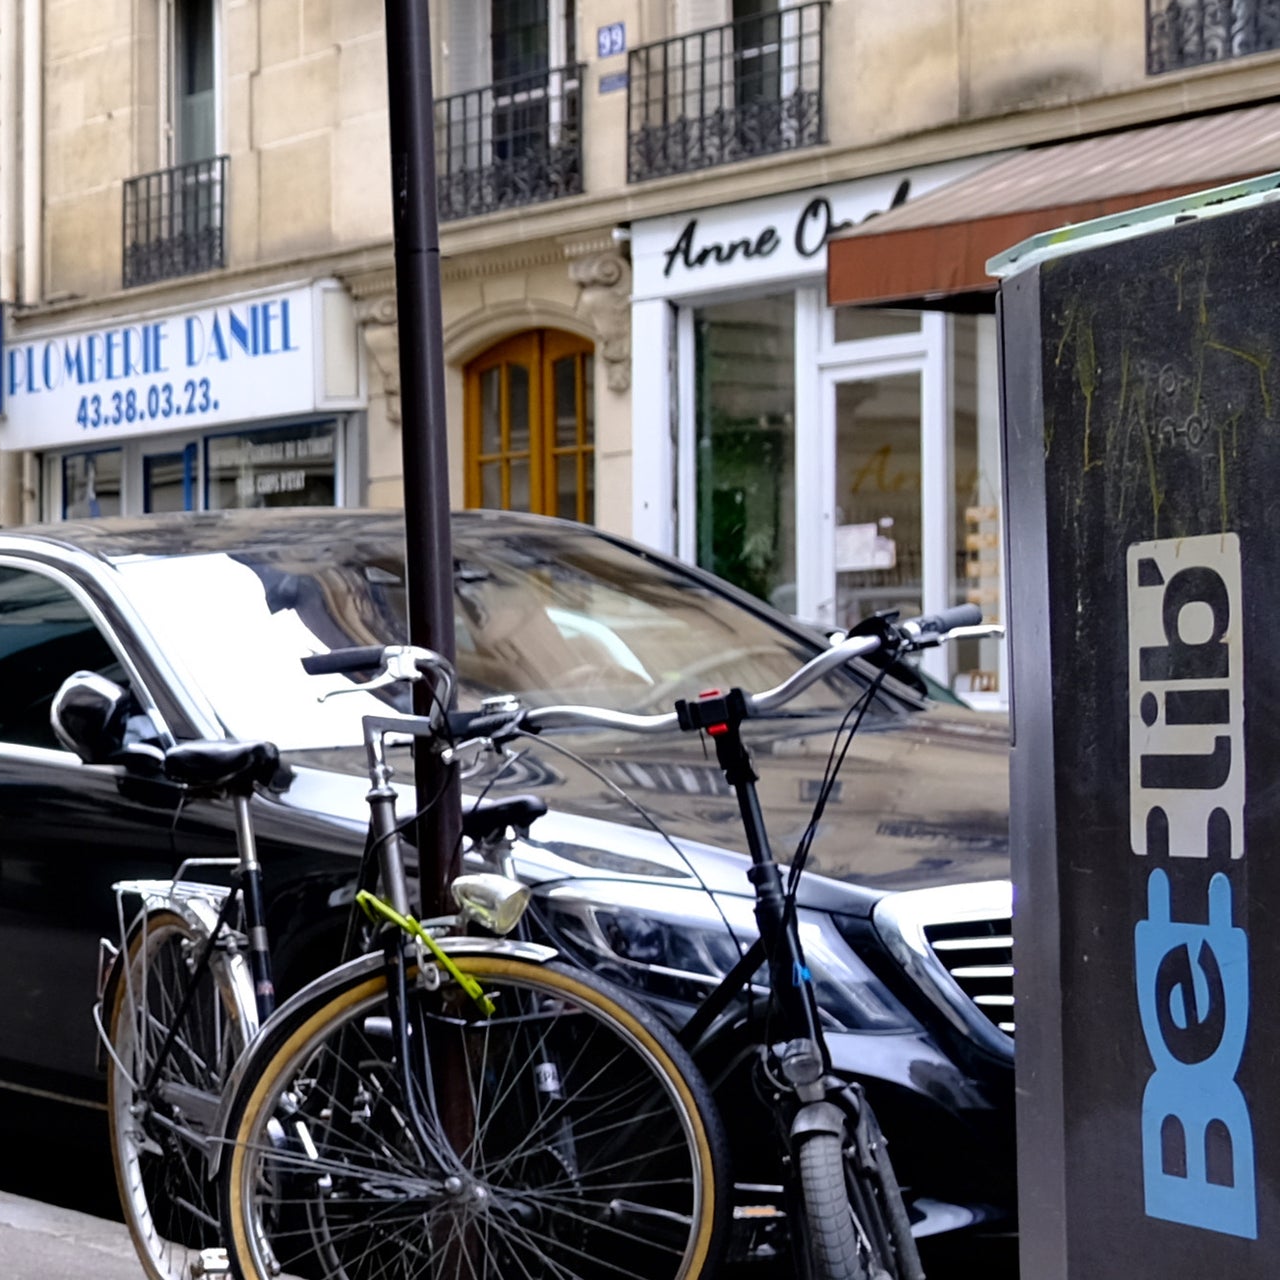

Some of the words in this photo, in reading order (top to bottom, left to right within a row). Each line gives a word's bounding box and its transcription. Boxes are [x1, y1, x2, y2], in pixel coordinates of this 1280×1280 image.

[663, 219, 781, 276] Anne
[7, 320, 170, 396] PLOMBERIE
[185, 297, 300, 368] DANIEL
[76, 376, 220, 429] 43.38.03.23.
